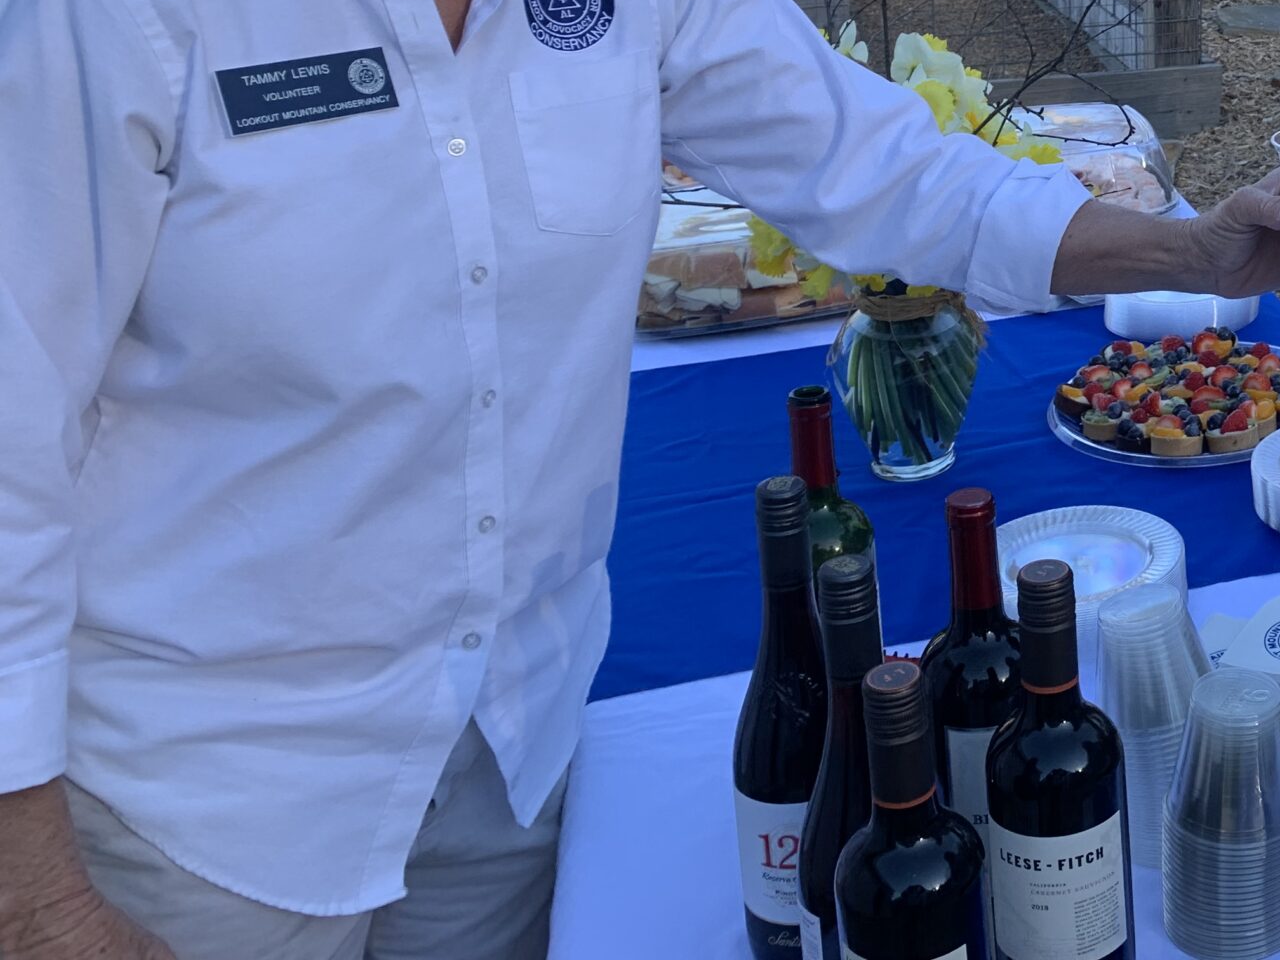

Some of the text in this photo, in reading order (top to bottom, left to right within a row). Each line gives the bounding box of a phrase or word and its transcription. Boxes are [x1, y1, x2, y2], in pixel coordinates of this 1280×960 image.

[560, 9, 575, 19] AL
[530, 10, 612, 51] CONSERVANCY
[545, 16, 592, 34] ADVOCACY
[240, 70, 287, 87] TAMMY
[290, 63, 331, 80] LEWIS
[262, 85, 322, 102] VOLUNTEER
[236, 94, 391, 128] LOOKOUT MOUNTAIN CONSERVANCY
[1031, 903, 1049, 912] 2018
